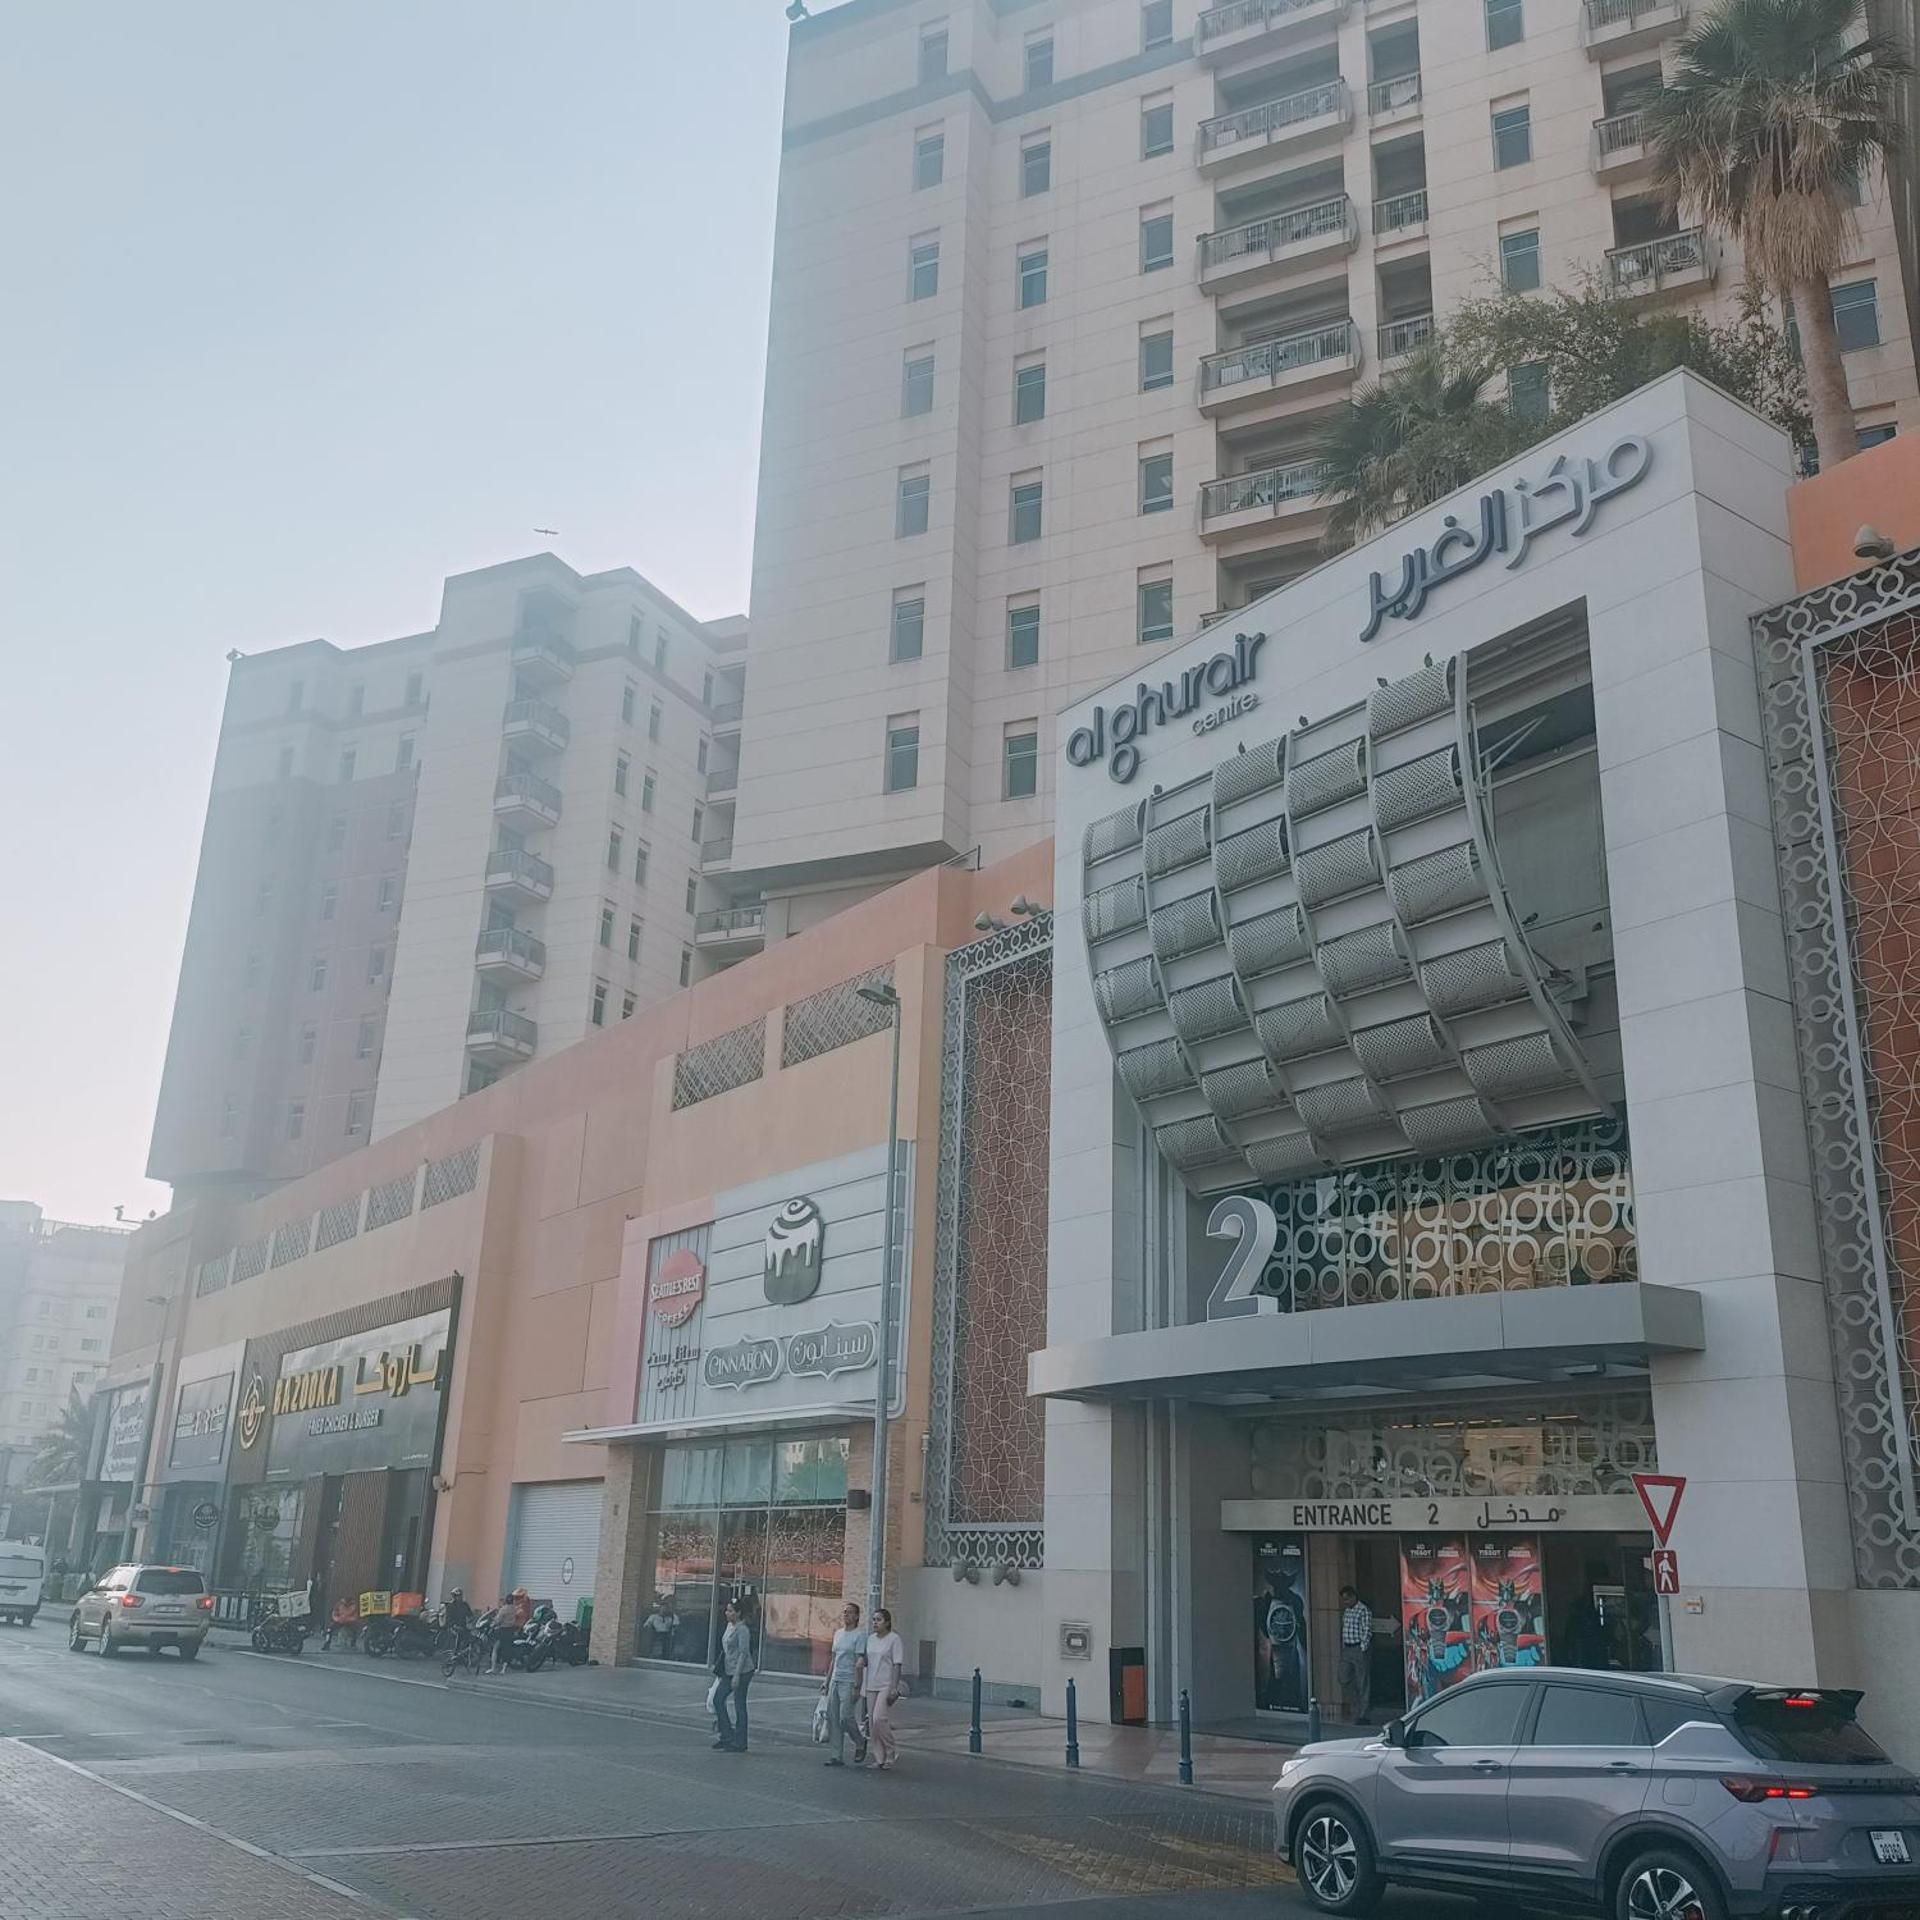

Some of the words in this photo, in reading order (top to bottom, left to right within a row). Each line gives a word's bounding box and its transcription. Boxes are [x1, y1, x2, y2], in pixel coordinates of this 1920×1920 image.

[1504, 435, 1653, 571] مركز
[1360, 488, 1508, 642] الغرير
[1192, 692, 1259, 736] centre
[1206, 1195, 1279, 1322] 2
[682, 1273, 701, 1293] BEST
[657, 1303, 690, 1323] COFFEE
[709, 1349, 774, 1377] CINNABON
[793, 1334, 868, 1366] سينابون
[353, 1344, 442, 1397] بازوكا
[272, 1366, 341, 1415] BAZOOKA
[1293, 1503, 1392, 1526] ENTRANCE
[1427, 1503, 1439, 1525] 2
[1477, 1502, 1559, 1529] مدخل
